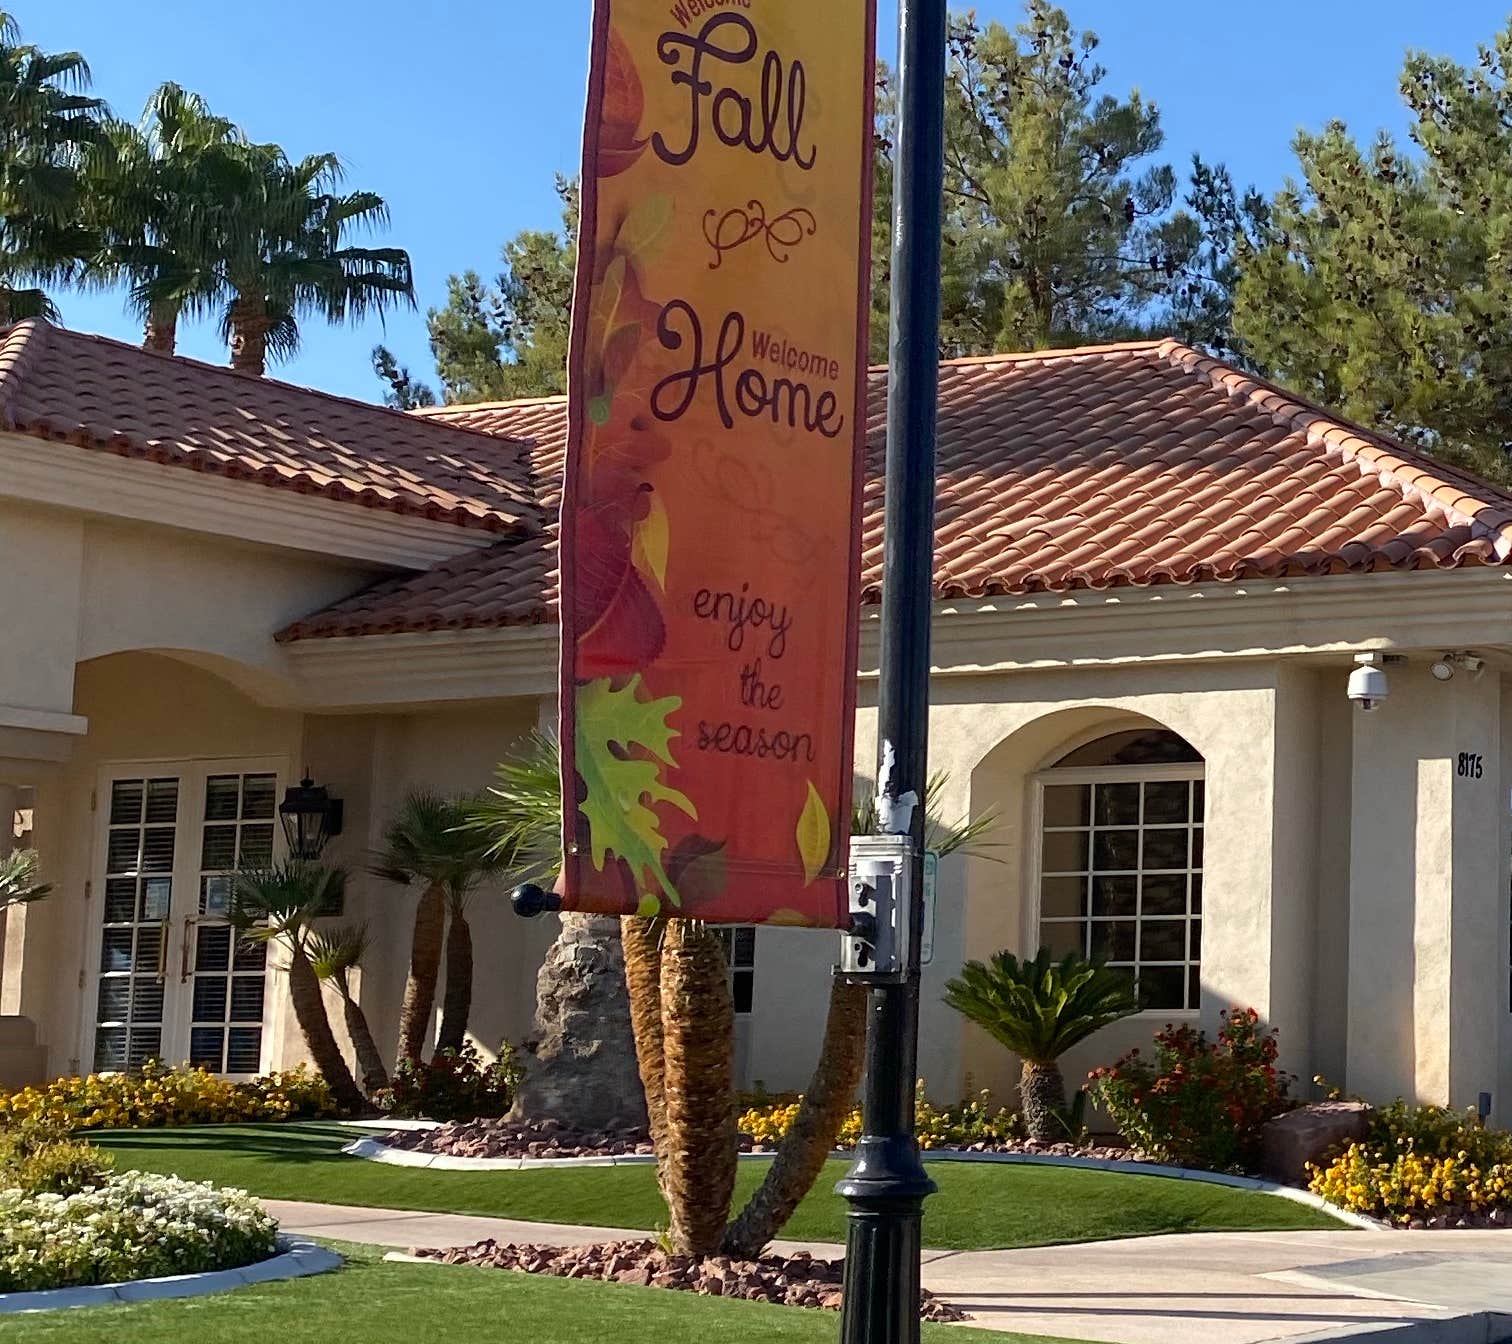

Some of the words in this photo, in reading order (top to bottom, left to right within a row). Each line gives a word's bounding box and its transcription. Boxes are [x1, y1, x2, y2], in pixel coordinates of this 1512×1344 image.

[651, 11, 817, 171] Fall
[650, 298, 844, 439] Home
[751, 329, 841, 381] Welcome
[693, 581, 793, 660] enjoy
[739, 656, 784, 711] the
[697, 719, 817, 763] season
[1457, 751, 1483, 779] 8175
